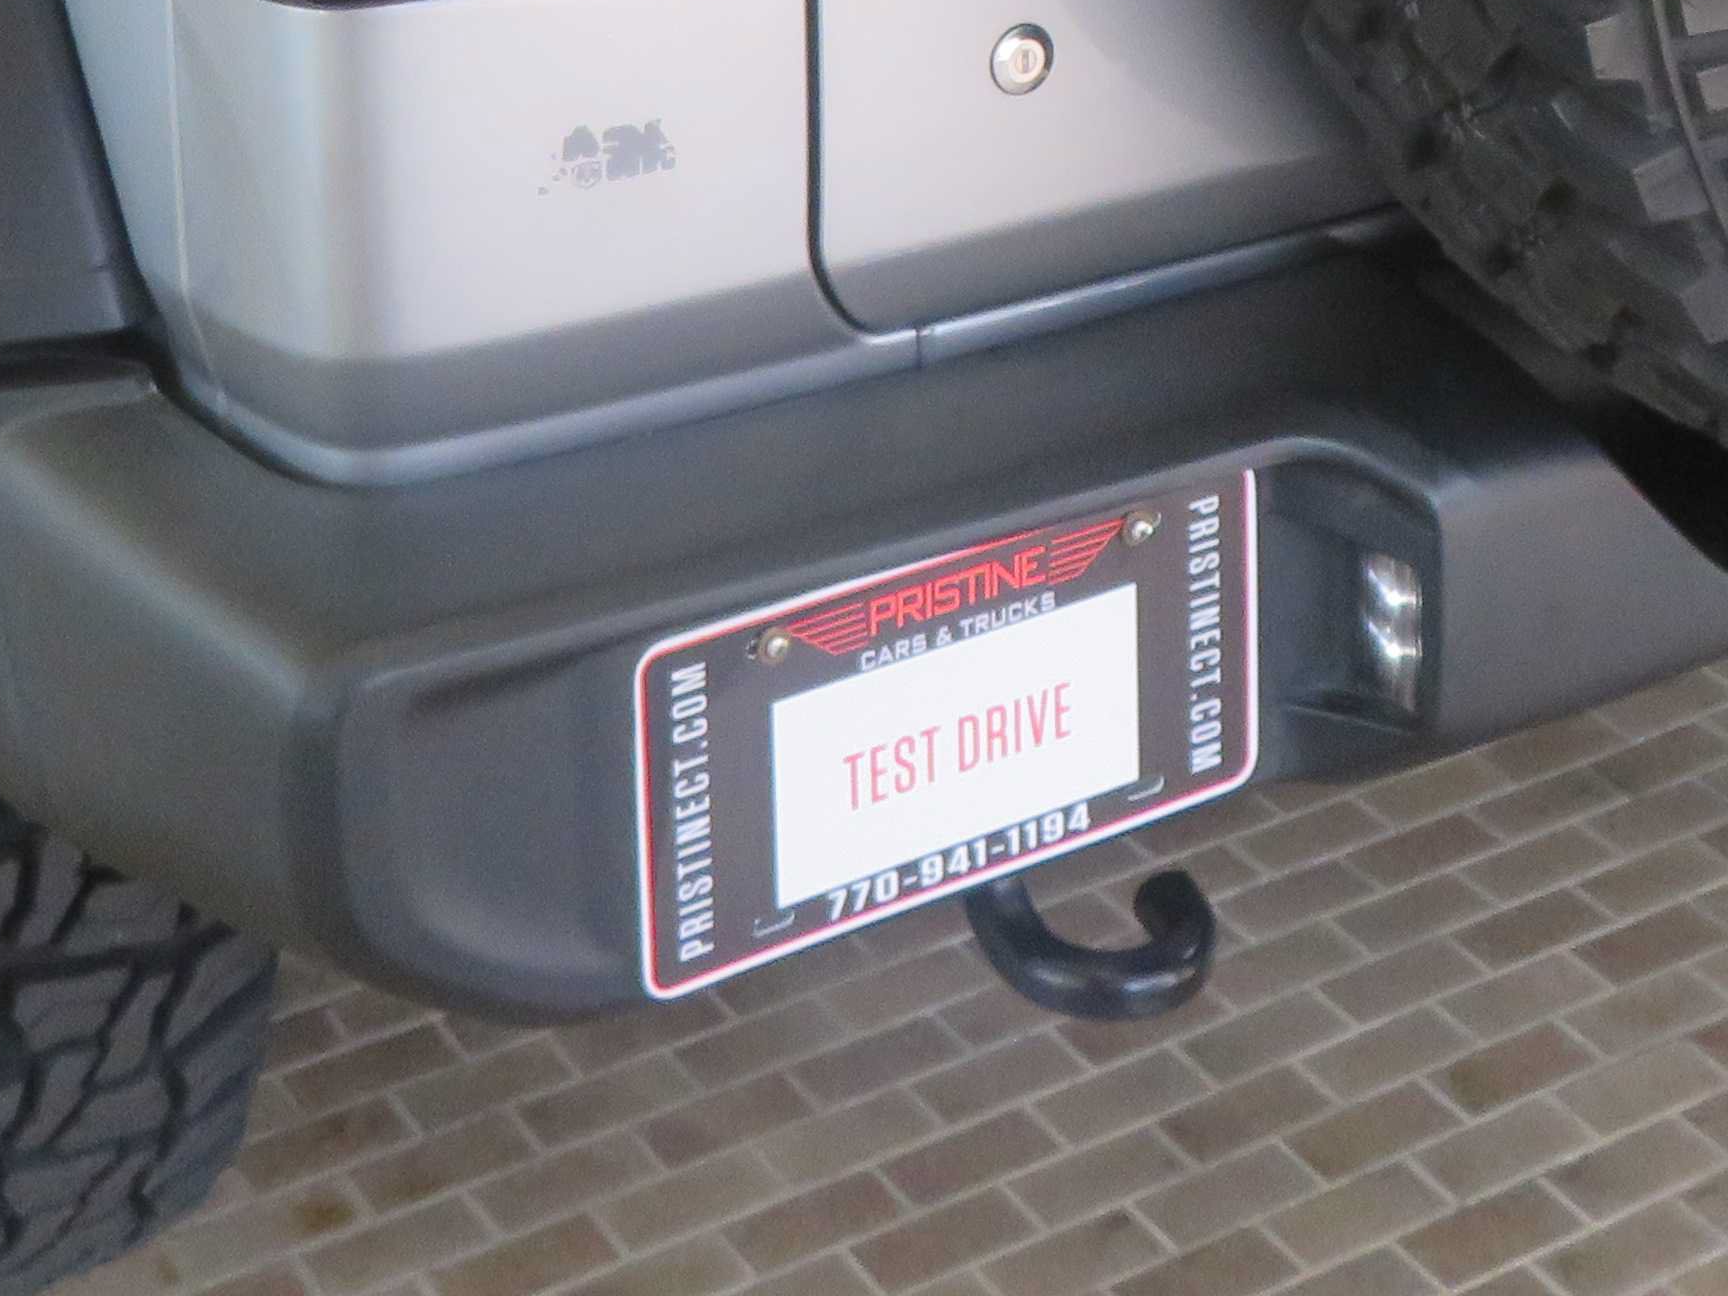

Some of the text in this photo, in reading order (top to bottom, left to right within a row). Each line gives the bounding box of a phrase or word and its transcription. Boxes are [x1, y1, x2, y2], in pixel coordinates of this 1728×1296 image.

[860, 591, 1057, 672] CARS & TRUCKS
[870, 545, 1047, 636] PRISTINE
[1186, 494, 1224, 776] PRISTINECT.COM
[843, 682, 1072, 811] TEST DRIVE
[671, 661, 715, 963] PRISTINECT.COM
[827, 800, 1092, 923] 770-941-1194
